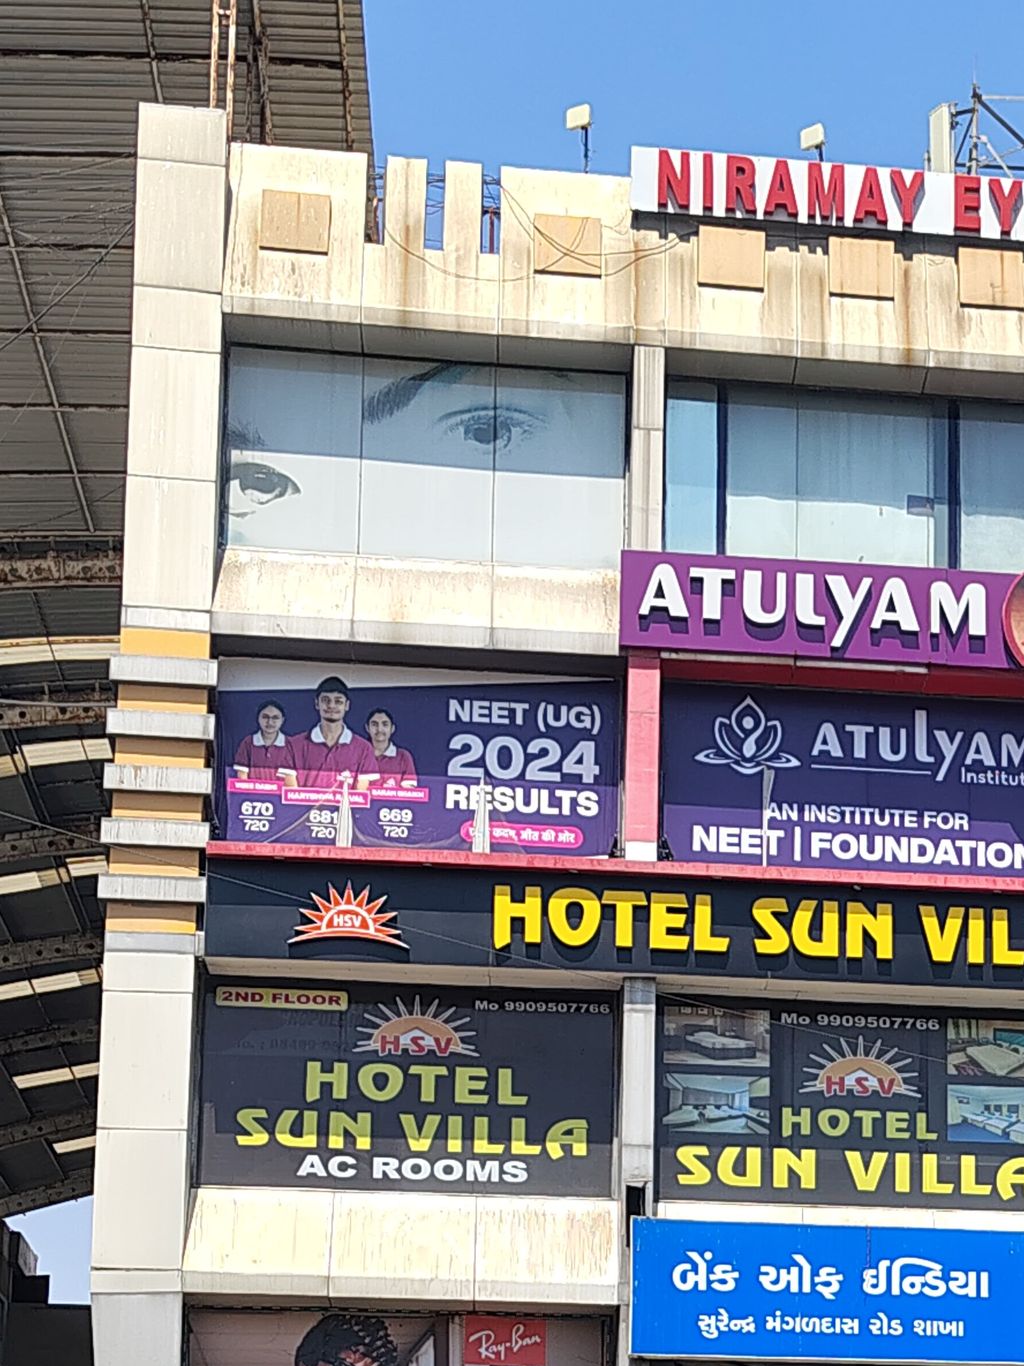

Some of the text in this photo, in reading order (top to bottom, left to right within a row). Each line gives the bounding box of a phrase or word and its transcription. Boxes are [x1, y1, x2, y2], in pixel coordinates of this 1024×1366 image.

[658, 148, 926, 226] NIRAMAY
[638, 563, 987, 648] ATULYAM
[448, 698, 601, 734] NEET (UG)
[447, 733, 600, 784] 2024
[241, 801, 274, 817] 670
[308, 810, 338, 823] 681
[379, 808, 412, 823] 669
[767, 802, 969, 831] AN INSTITUTE FOR
[244, 820, 269, 831] 720
[310, 827, 335, 838] 720
[383, 826, 408, 838] 720
[691, 824, 785, 857] NEET
[333, 912, 362, 928] HSV
[493, 884, 730, 953] HOTEL
[752, 897, 894, 960] SUN
[222, 990, 342, 1007] 2ND FLOOR
[475, 1000, 611, 1015] Mo 9909507766
[781, 1012, 940, 1031] Mo 9909507766
[378, 1033, 454, 1057] HSV
[305, 1060, 529, 1105] HOTEL
[825, 1075, 896, 1098] HSV
[236, 1108, 589, 1160] SUN VILLA
[781, 1107, 939, 1141] HOTEL
[297, 1154, 529, 1183] AC ROOMS
[675, 1145, 817, 1190] SUN
[672, 1251, 739, 1291] બેંક
[759, 1254, 844, 1299] ઓફ
[698, 1308, 964, 1339] સુરેન્દ્ર મંગળદાસ રોડ શાખા
[468, 1324, 541, 1360] Ray-Ban
